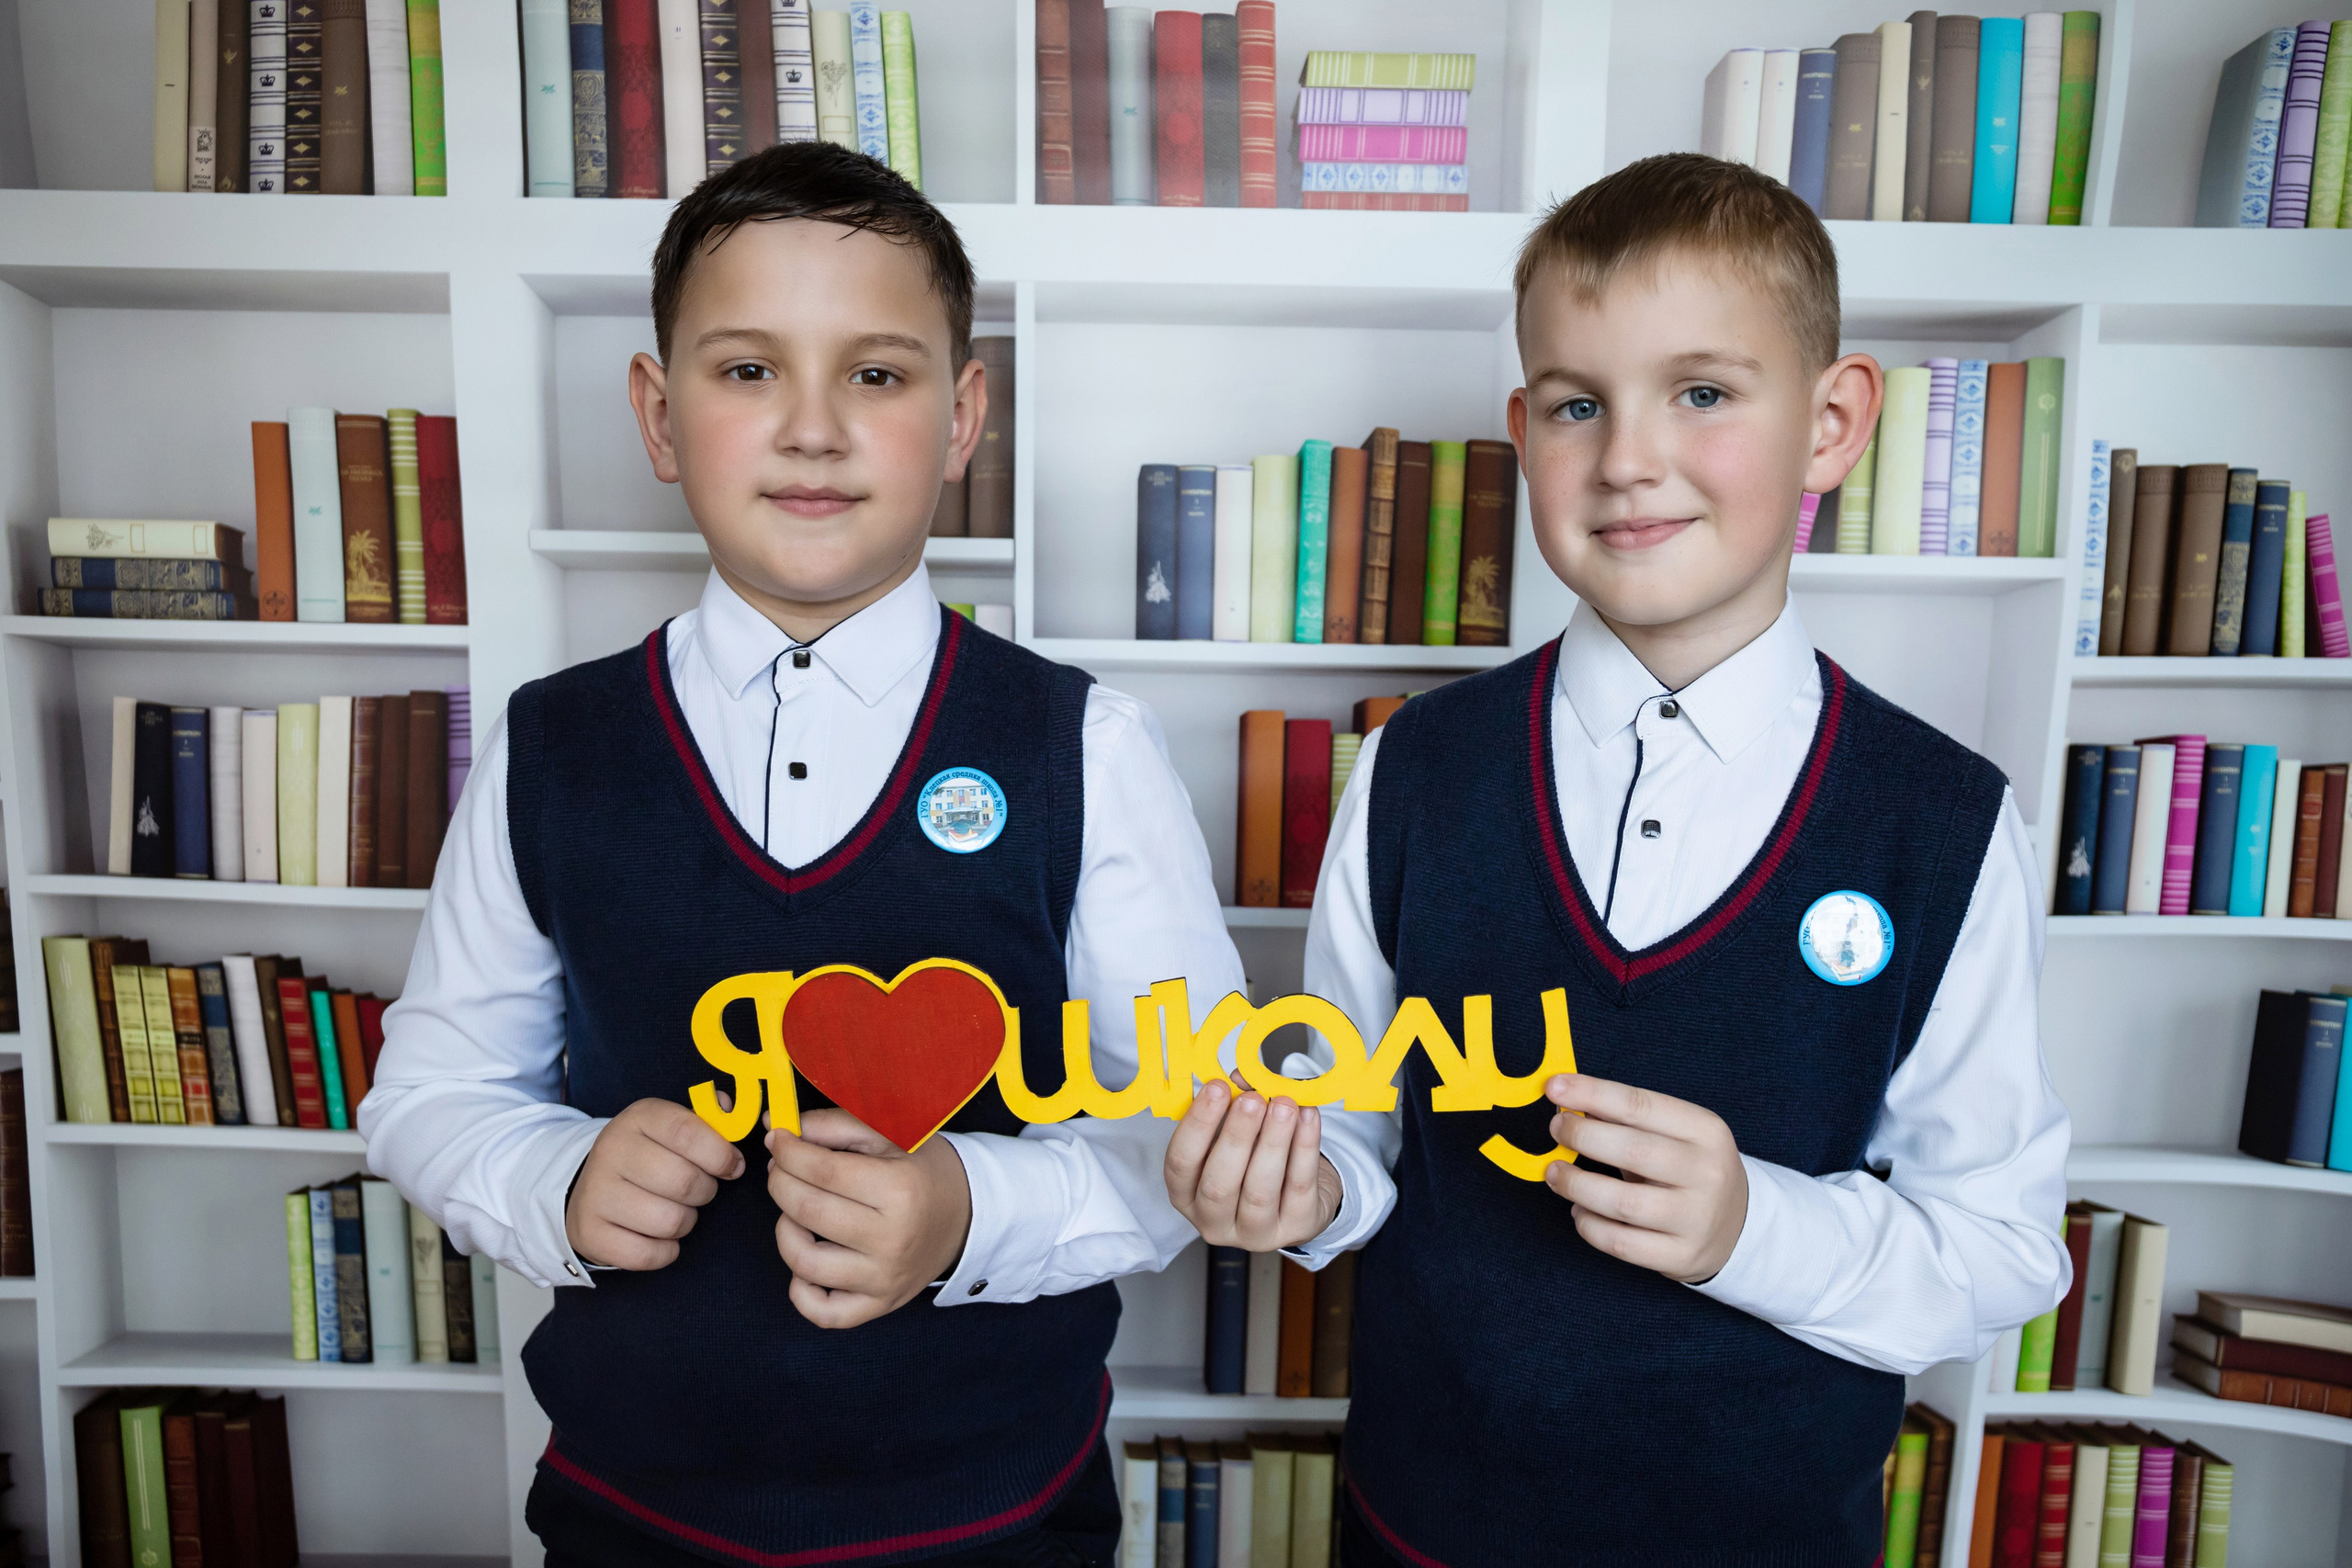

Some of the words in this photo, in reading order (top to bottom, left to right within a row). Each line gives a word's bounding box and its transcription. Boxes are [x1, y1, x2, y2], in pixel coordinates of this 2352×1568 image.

[952, 771, 981, 781] средняя
[981, 778, 999, 798] школа
[688, 970, 802, 1142] Я
[995, 977, 1578, 1182] школу
